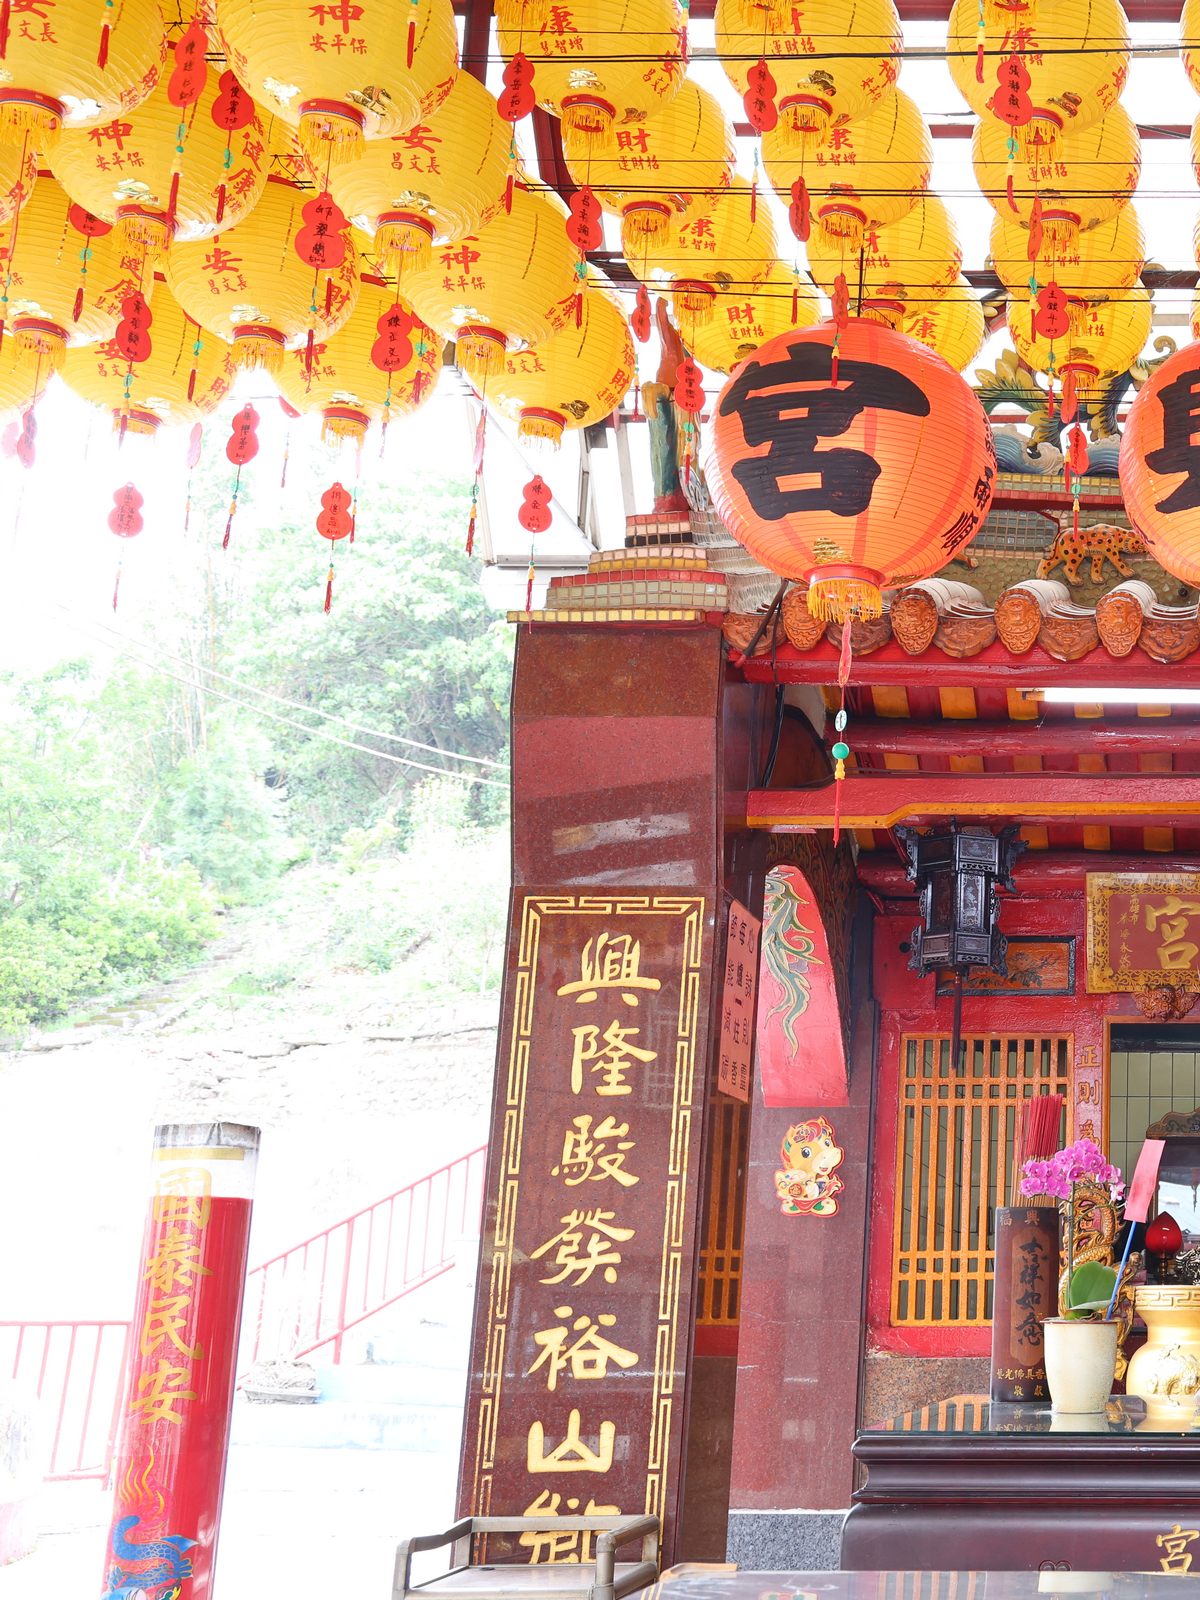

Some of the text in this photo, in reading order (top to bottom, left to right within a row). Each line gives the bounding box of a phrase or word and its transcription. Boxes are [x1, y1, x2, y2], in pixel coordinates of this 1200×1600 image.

[616, 127, 651, 154] 財
[727, 303, 755, 325] 財
[129, 1166, 213, 1425] 國泰民安
